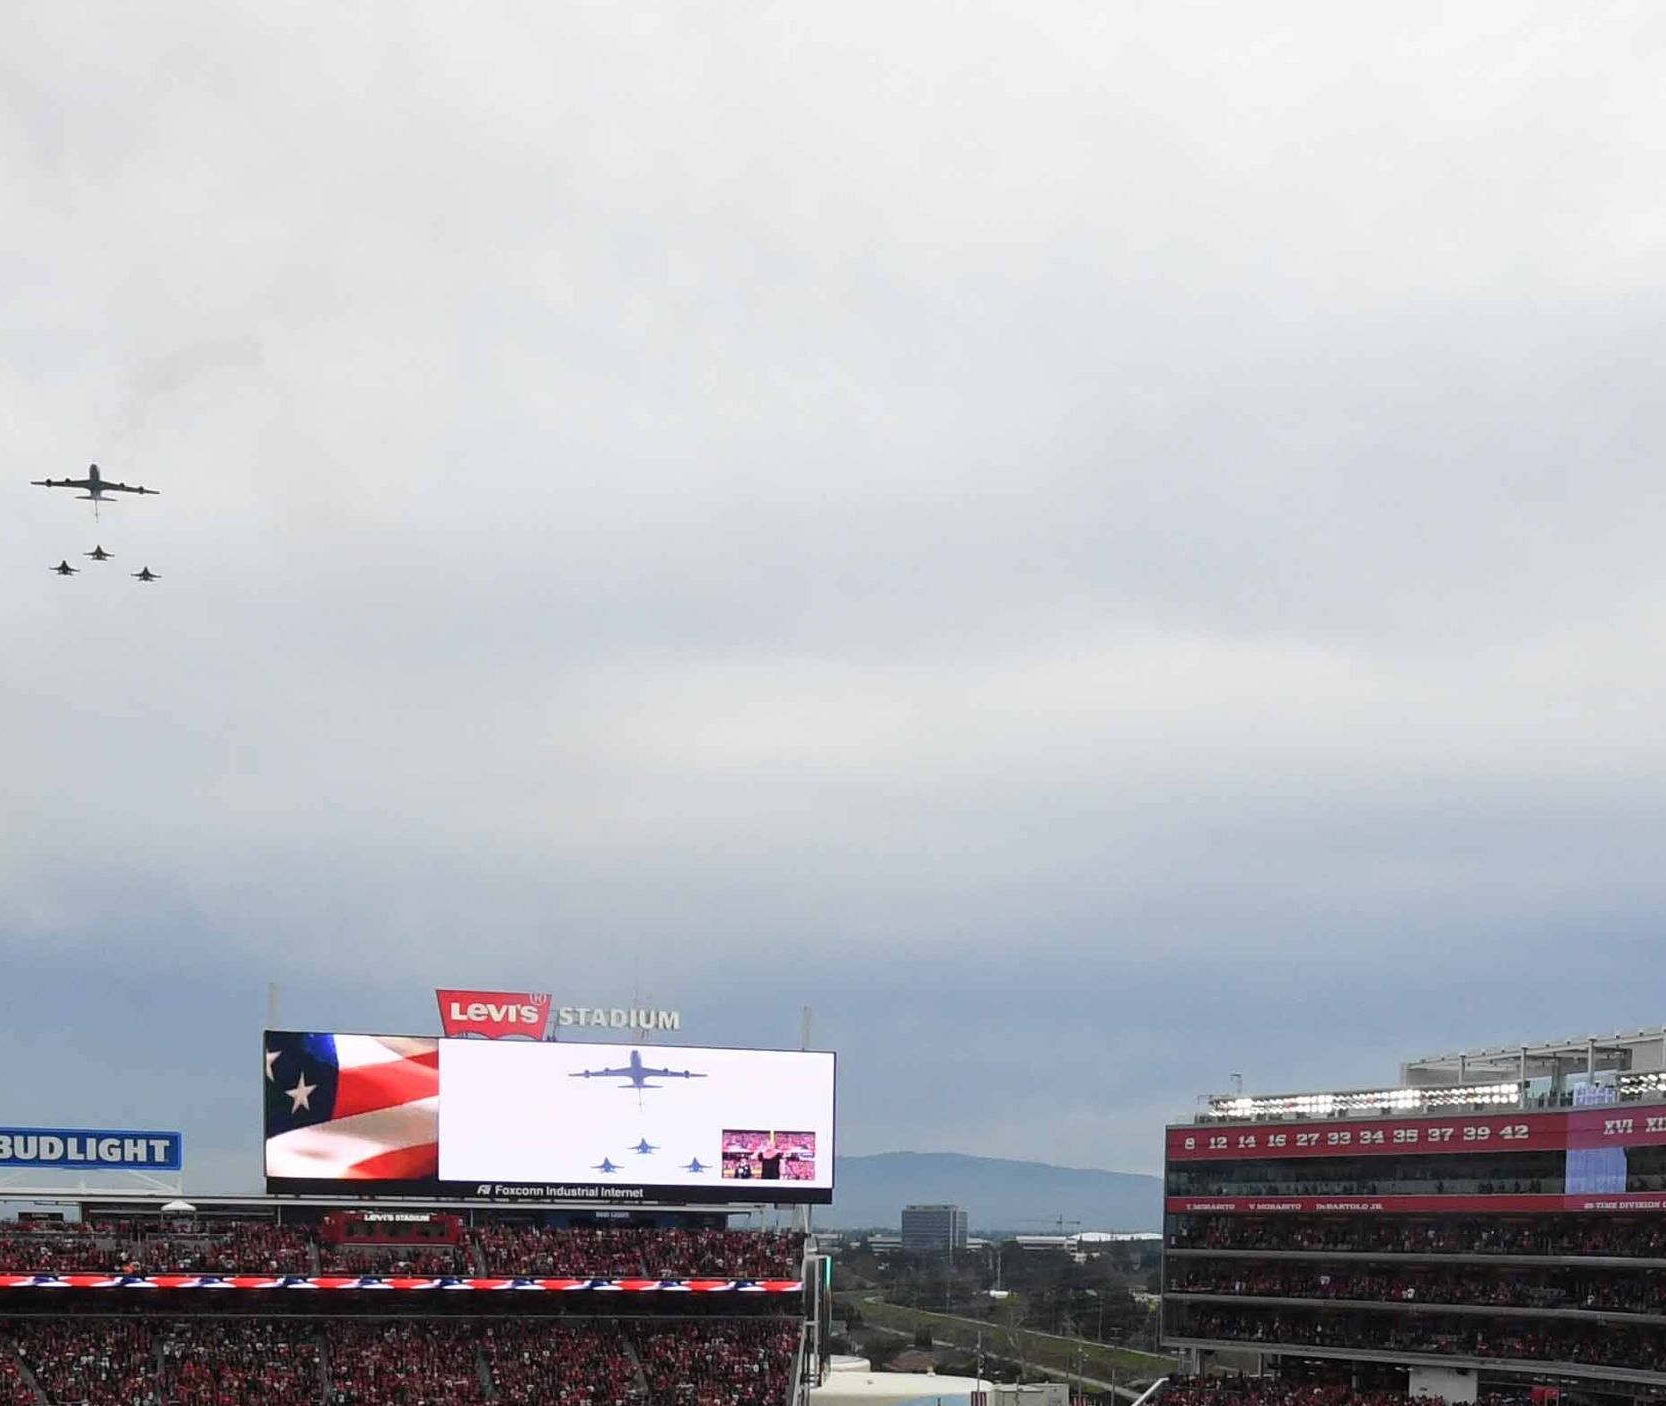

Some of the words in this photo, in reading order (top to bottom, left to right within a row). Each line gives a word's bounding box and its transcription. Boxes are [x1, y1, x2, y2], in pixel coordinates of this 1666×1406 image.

[558, 1007, 681, 1030] STADIUM
[1603, 1118, 1634, 1135] XVI
[1184, 1137, 1196, 1150] 8
[1208, 1136, 1228, 1149] 12
[1237, 1135, 1256, 1148] 14
[1295, 1133, 1320, 1146] 27
[1327, 1132, 1351, 1145] 33
[1359, 1130, 1385, 1144] 34
[1393, 1129, 1418, 1143] 35
[1427, 1128, 1454, 1142] 37
[1462, 1126, 1491, 1141] 39
[1499, 1125, 1529, 1140] 42
[67, 1136, 171, 1163] LIGHT
[495, 1184, 544, 1196] Foxconn
[546, 1185, 599, 1197] Industrial
[601, 1187, 644, 1198] Internet
[1619, 1201, 1660, 1209] DIVISION
